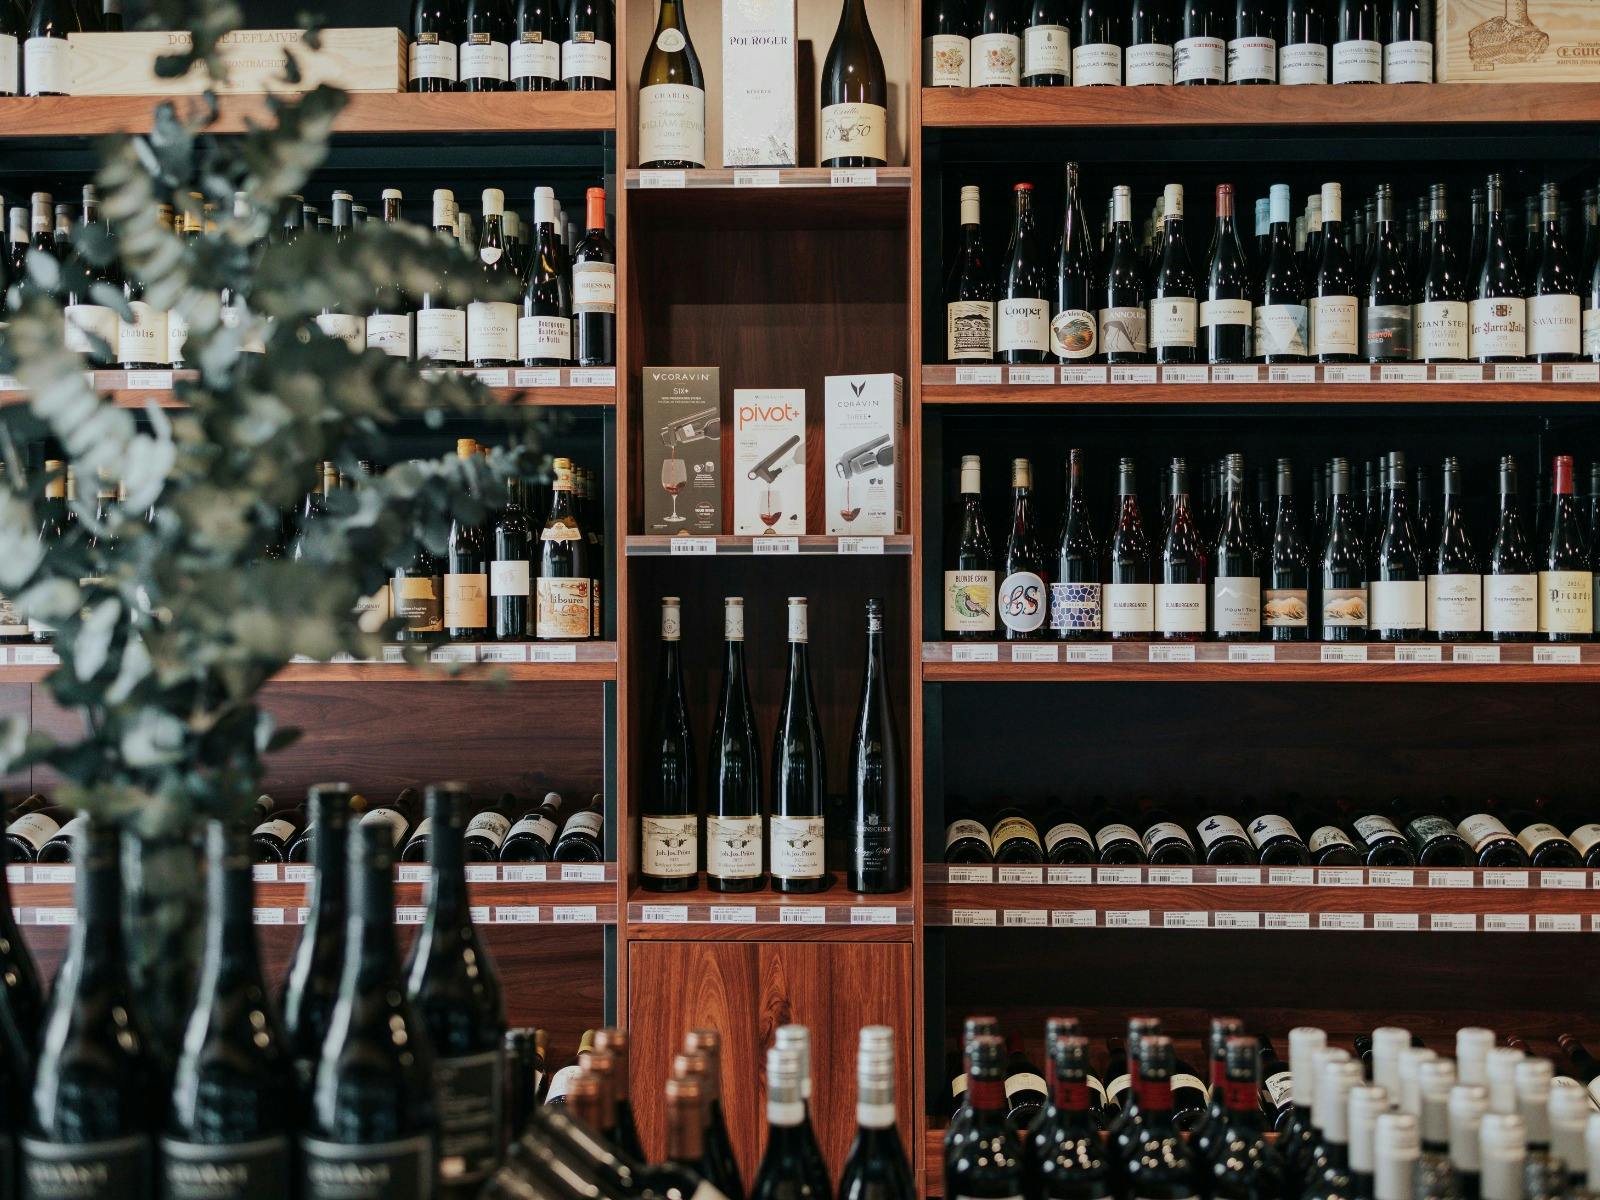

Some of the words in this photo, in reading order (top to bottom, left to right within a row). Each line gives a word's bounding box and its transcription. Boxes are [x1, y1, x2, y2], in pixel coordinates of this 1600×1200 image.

[752, 36, 788, 45] ROGER
[1005, 306, 1042, 319] Cooper
[1417, 320, 1445, 329] GIANT
[121, 327, 155, 338] Chablis
[660, 373, 709, 381] CORAVIN
[838, 400, 879, 408] CORAVIN
